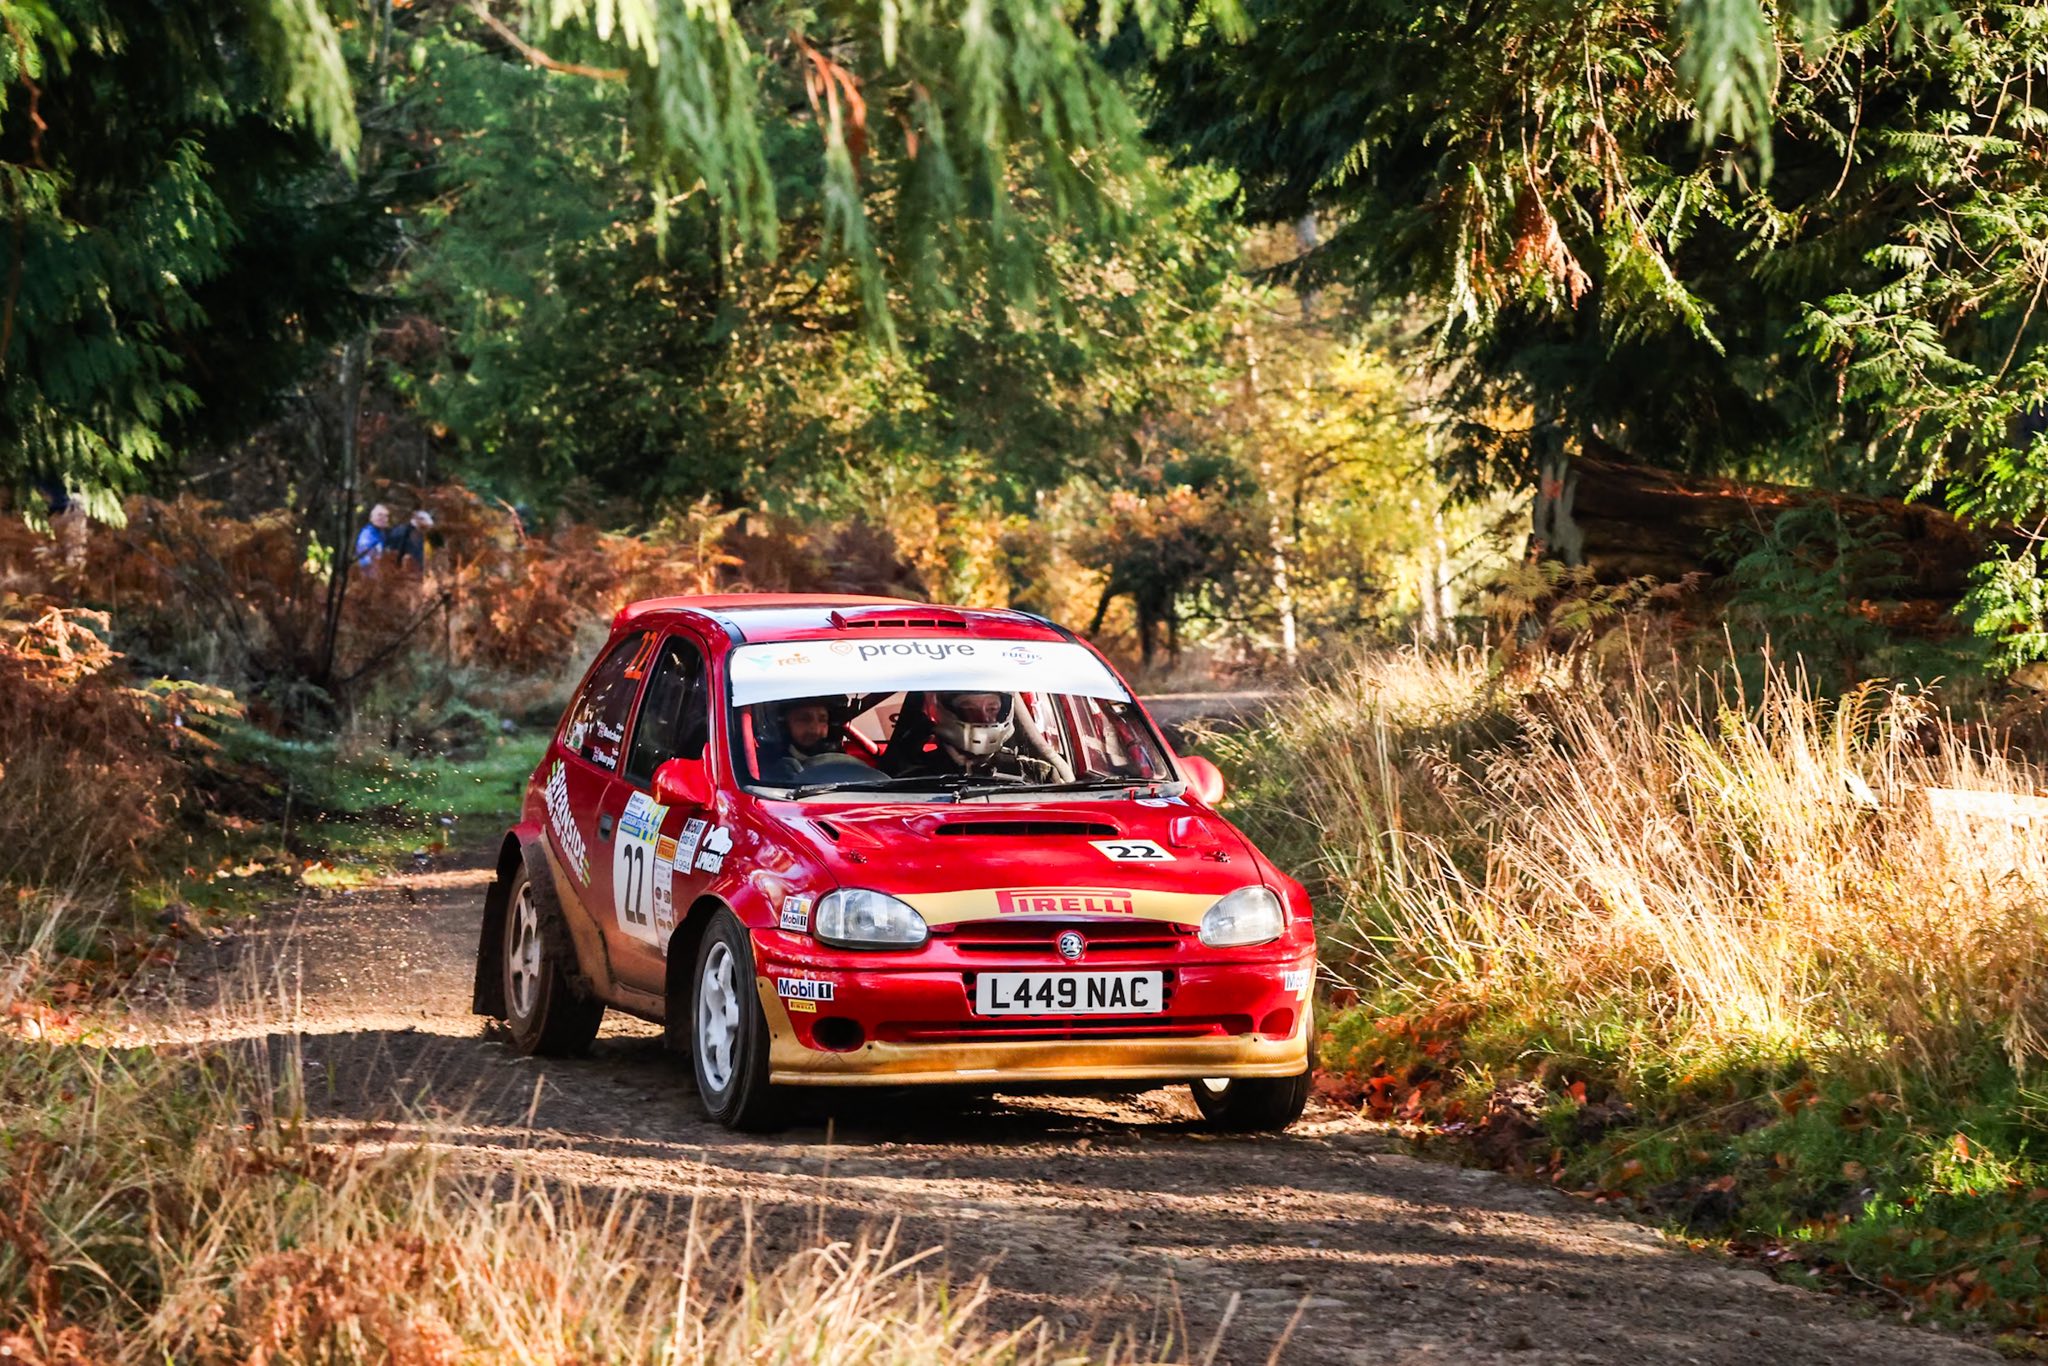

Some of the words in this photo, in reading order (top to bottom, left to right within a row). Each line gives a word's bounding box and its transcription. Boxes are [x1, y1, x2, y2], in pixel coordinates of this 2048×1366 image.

[858, 641, 975, 661] protyre
[1106, 846, 1163, 858] 22
[624, 844, 647, 926] 22
[995, 889, 1133, 914] PIRELLI
[782, 913, 800, 925] Mobil
[779, 979, 815, 998] Mobil
[818, 983, 832, 999] 1
[991, 978, 1076, 1009] L449
[1087, 977, 1149, 1008] NAC
